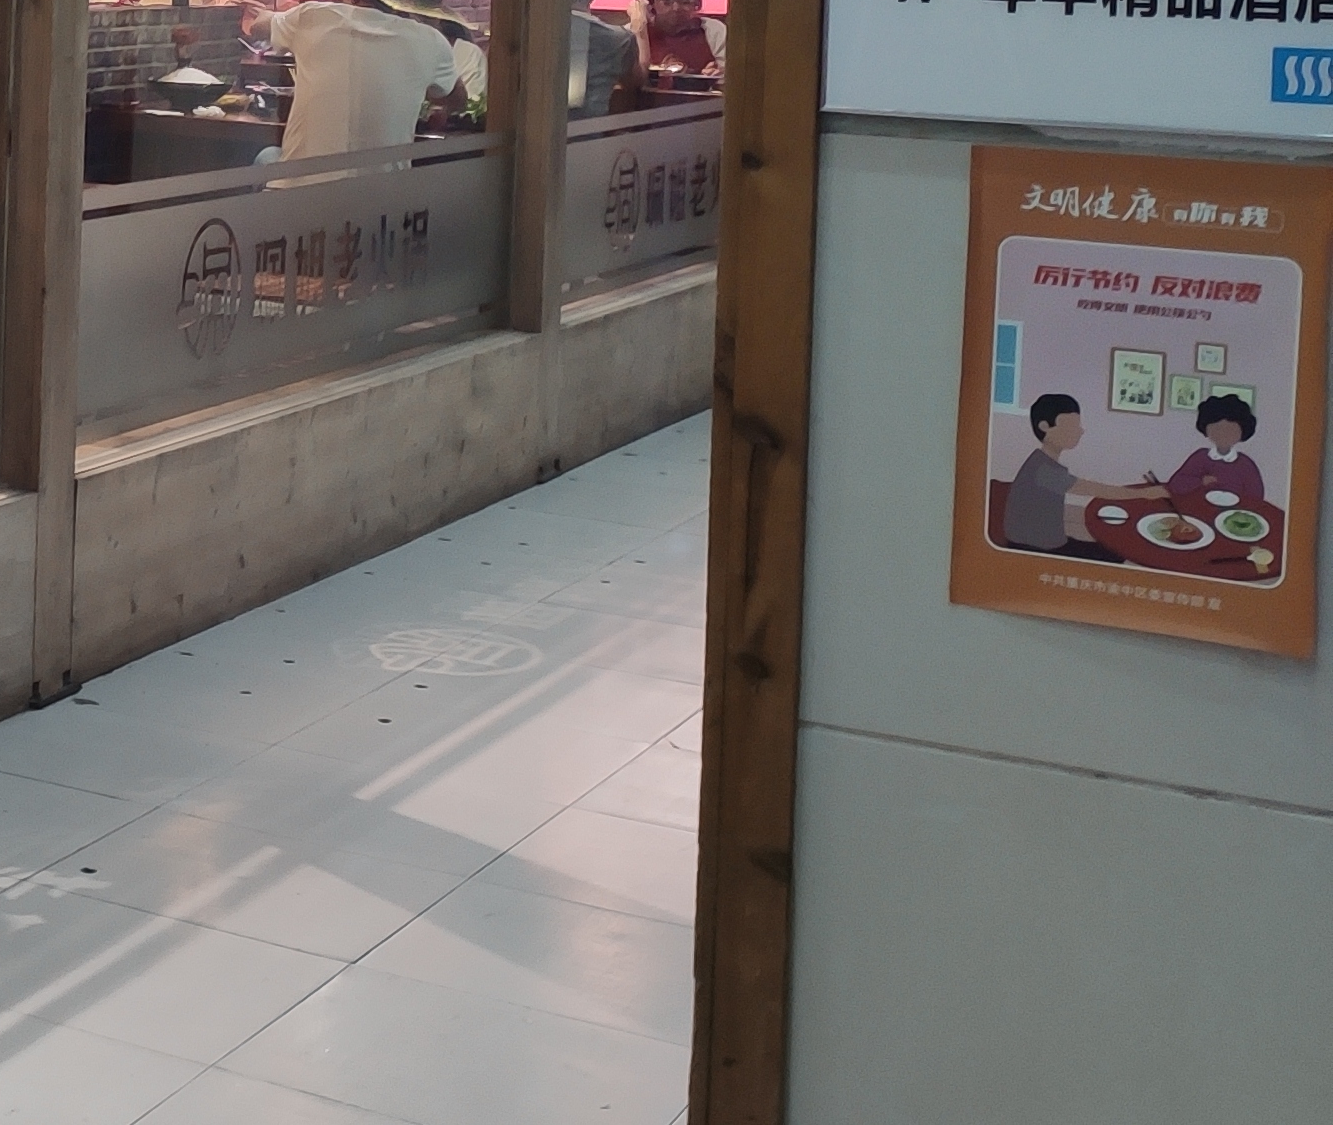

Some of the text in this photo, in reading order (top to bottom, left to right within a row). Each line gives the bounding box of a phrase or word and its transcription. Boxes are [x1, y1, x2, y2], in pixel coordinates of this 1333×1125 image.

[1021, 184, 1159, 223] 文明健康
[1034, 264, 1263, 303] 厉行节约 反对浪费
